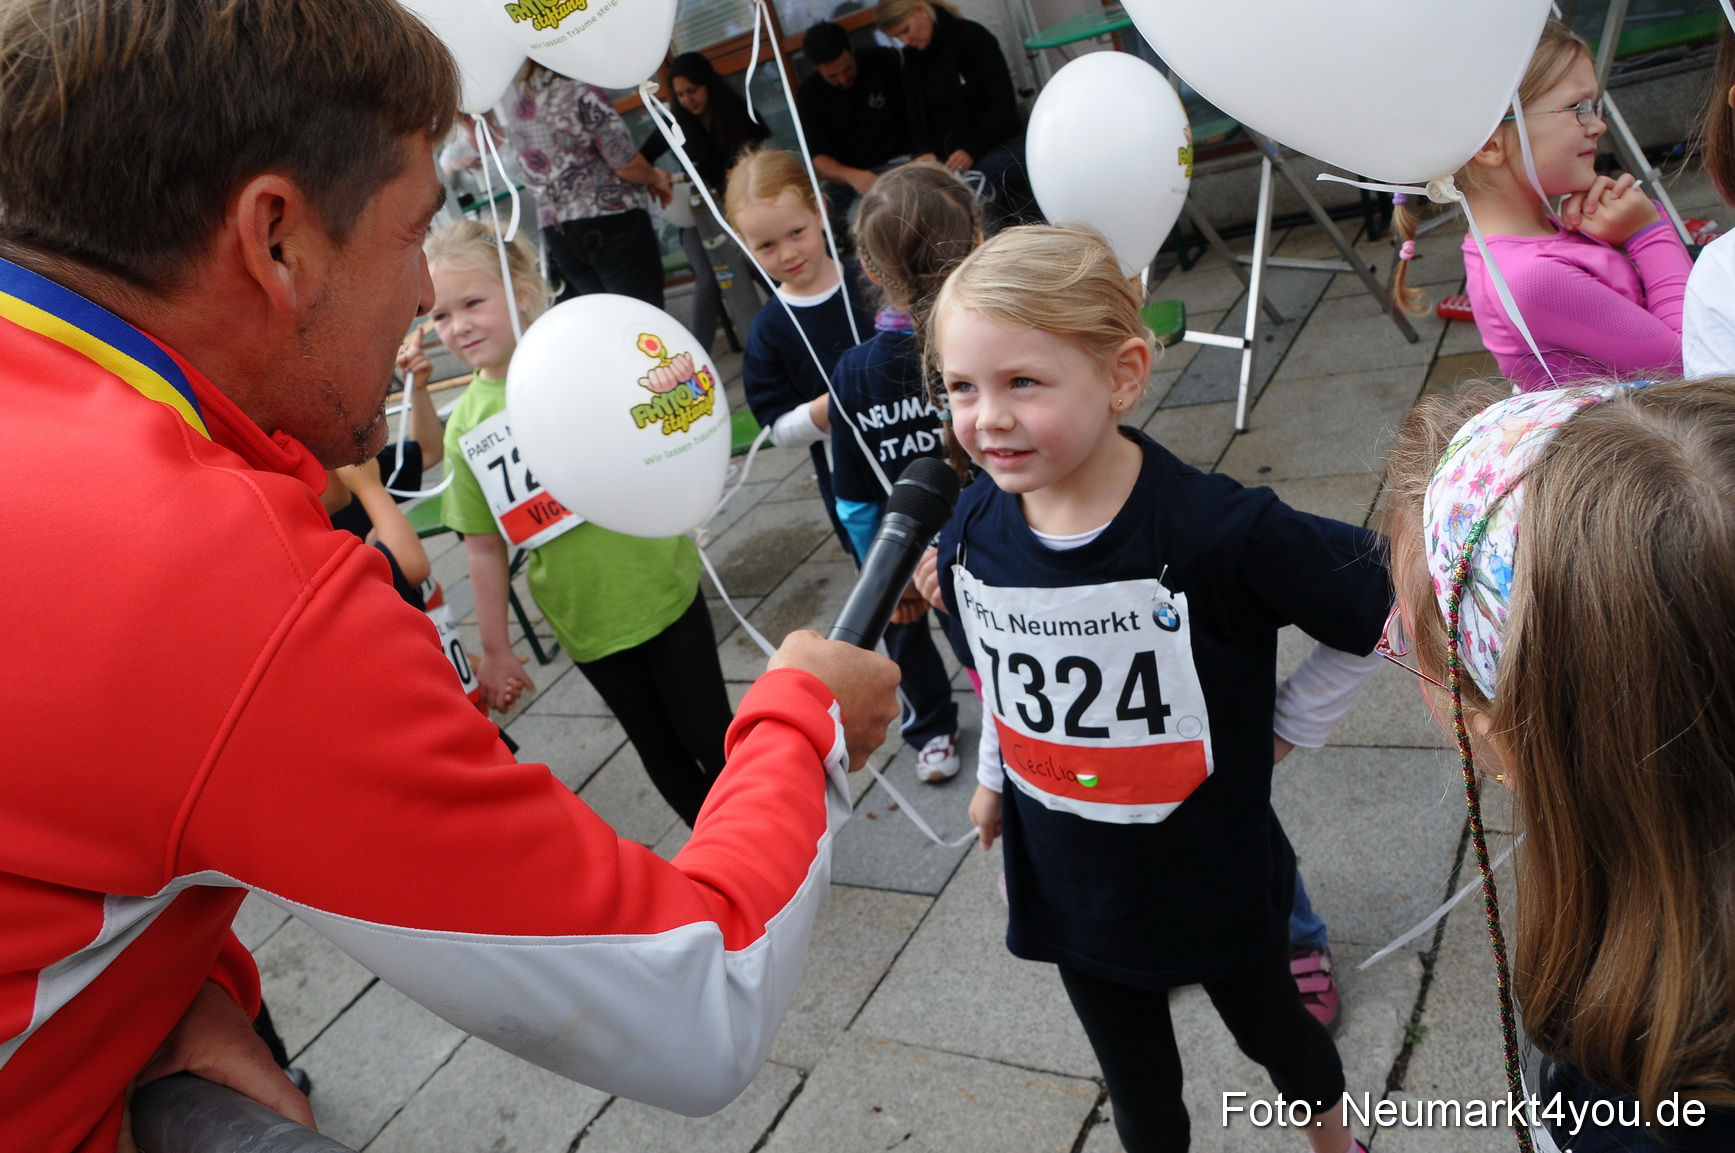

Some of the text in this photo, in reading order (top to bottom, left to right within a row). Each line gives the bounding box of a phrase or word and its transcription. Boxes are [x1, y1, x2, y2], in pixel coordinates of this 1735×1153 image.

[542, 35, 568, 48] lassen
[566, 15, 598, 38] Träume
[467, 432, 505, 460] PARTL
[527, 500, 567, 525] Vic
[963, 589, 1140, 637] PRTL Neumarkt
[1013, 744, 1079, 783] Cecilia
